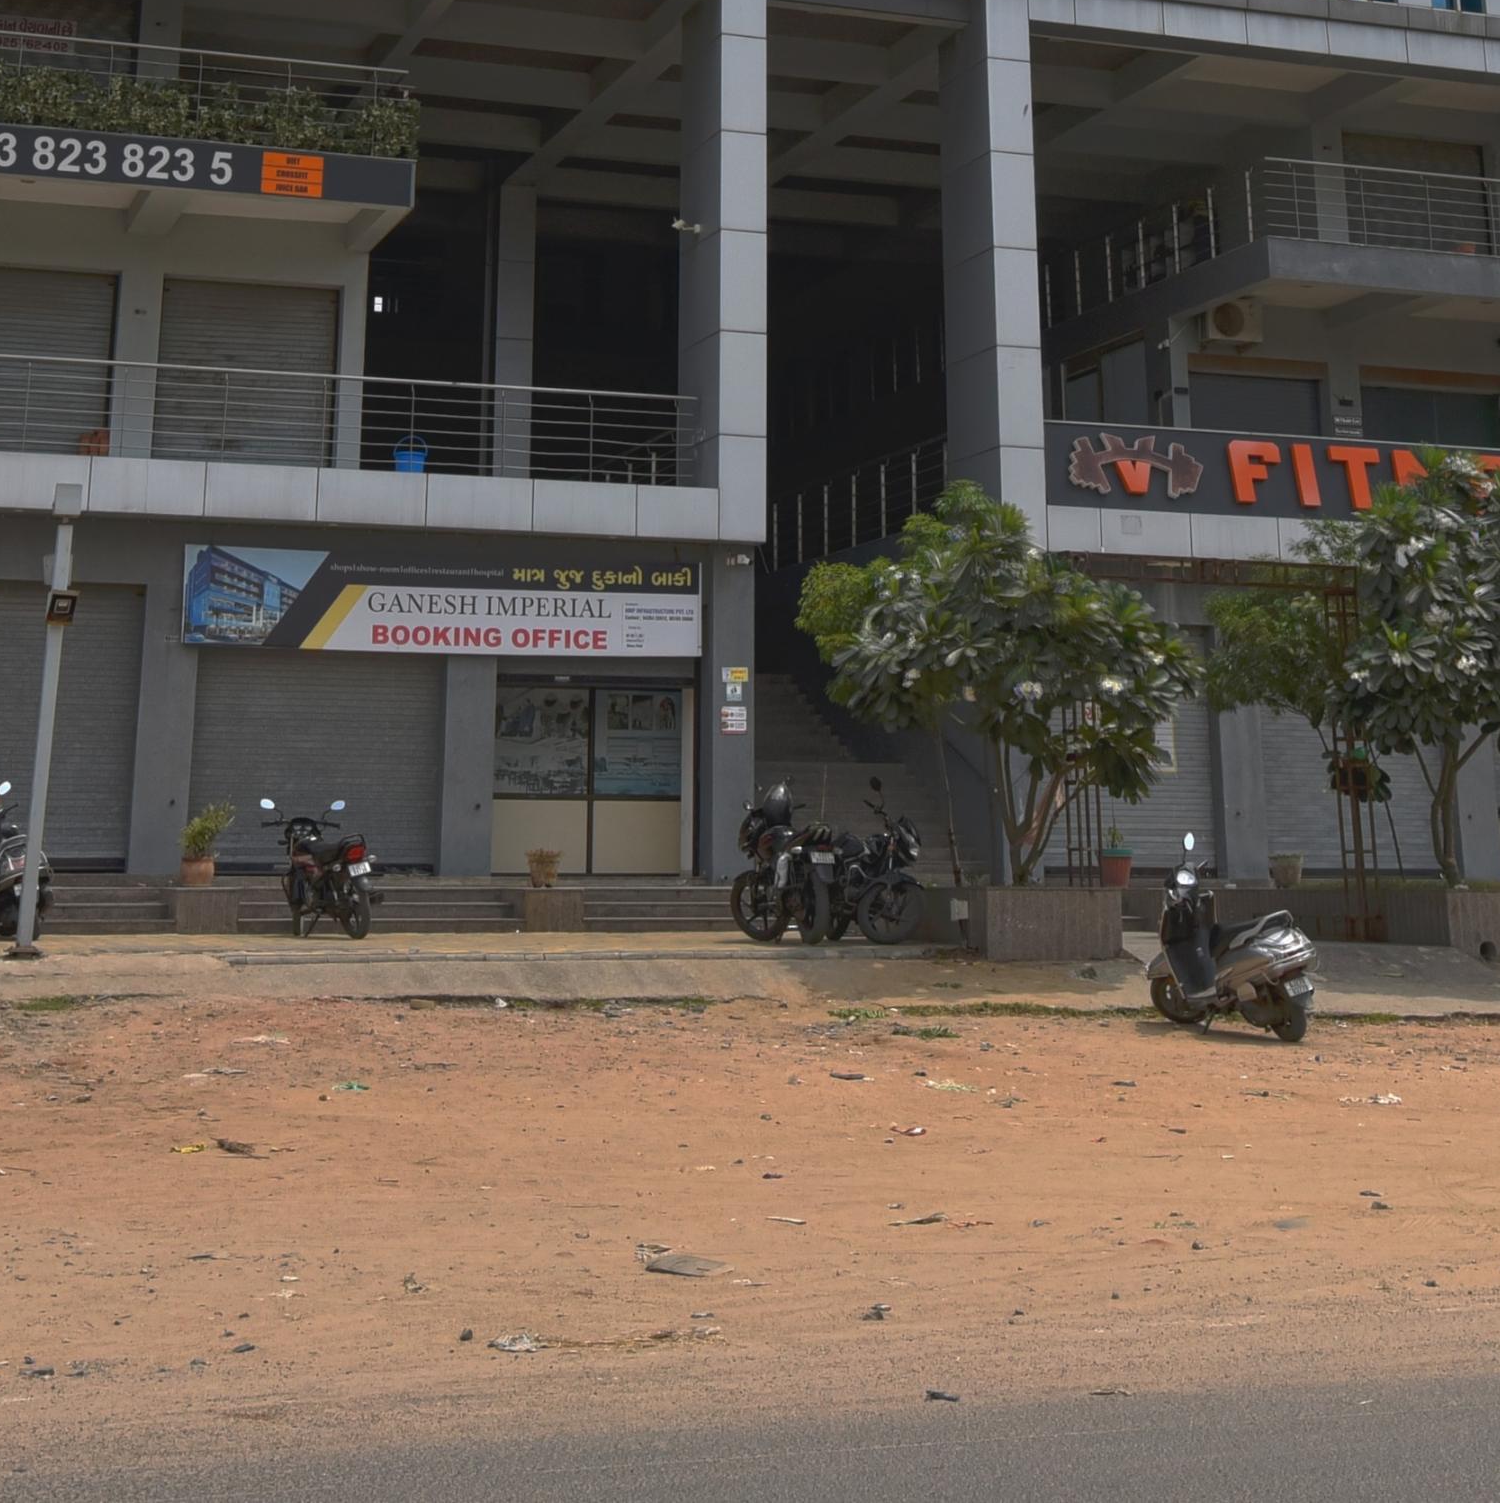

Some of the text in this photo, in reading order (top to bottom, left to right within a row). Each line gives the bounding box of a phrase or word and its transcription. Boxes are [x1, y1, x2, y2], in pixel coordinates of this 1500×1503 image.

[31, 134, 108, 176] 823
[120, 142, 196, 183] 823
[209, 151, 234, 186] 5
[512, 565, 693, 591] માત્ર જુજ દુકાનો બાકી
[366, 591, 612, 620] GANESH IMPERIAL
[371, 624, 502, 648] BOOKING
[511, 627, 608, 651] OFFICE
